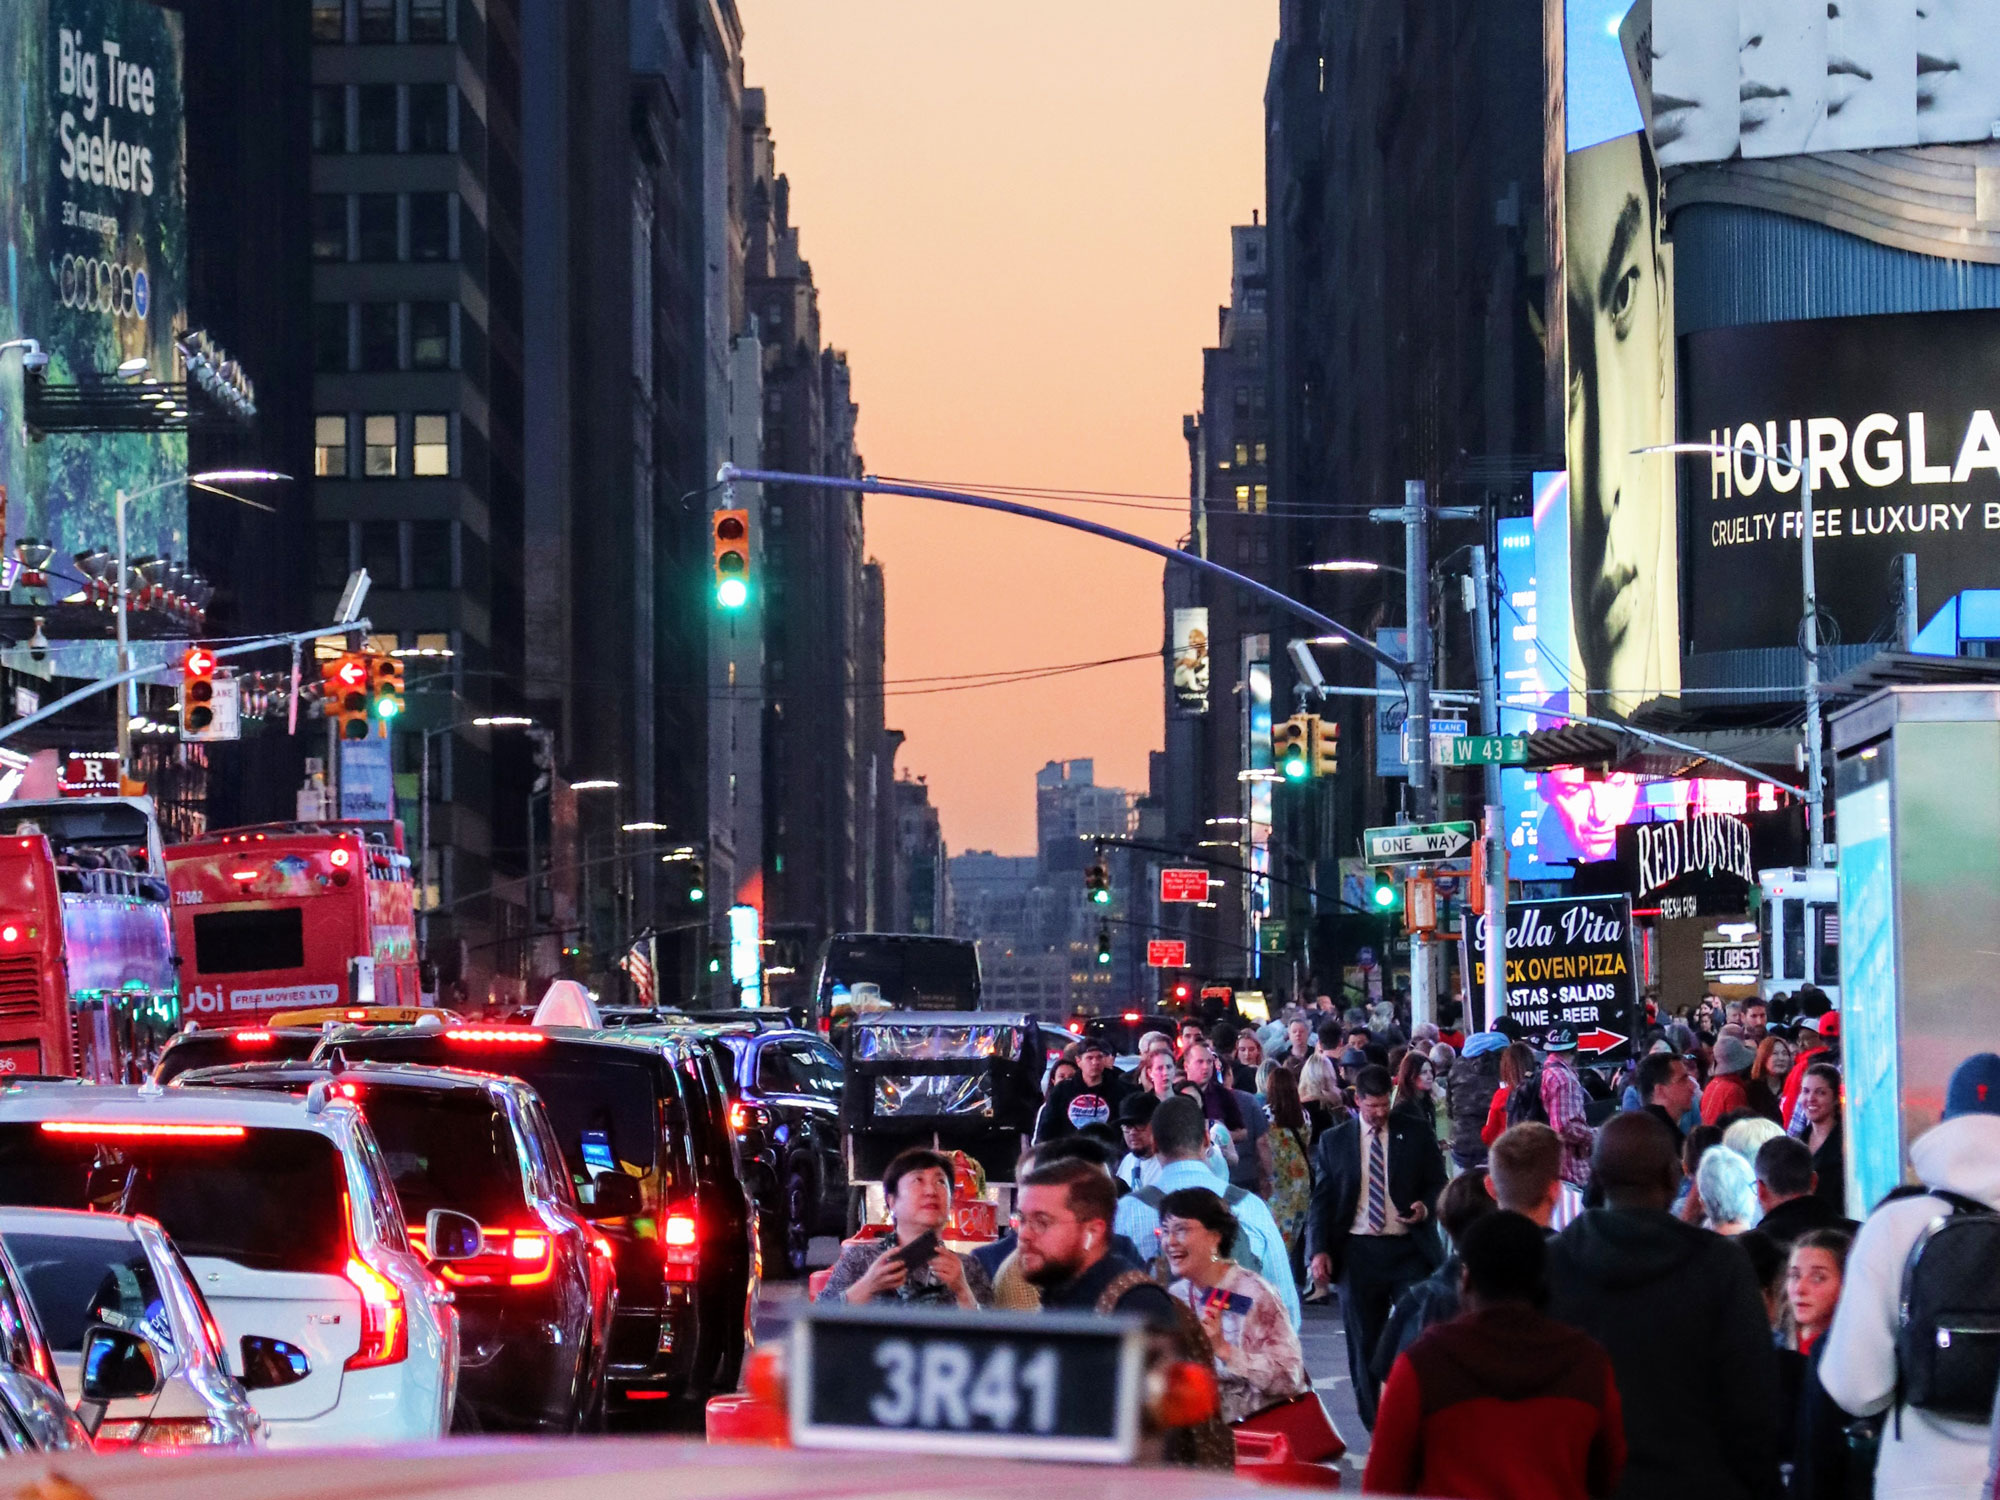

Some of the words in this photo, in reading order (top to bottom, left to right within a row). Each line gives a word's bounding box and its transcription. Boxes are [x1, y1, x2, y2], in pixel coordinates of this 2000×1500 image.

[59, 28, 98, 122] Big
[103, 39, 155, 116] Tree
[59, 111, 154, 197] Seekers
[1711, 409, 2000, 500] HOURGLA
[1711, 512, 1776, 547] CRUELTY
[1852, 503, 1972, 536] LUXURY
[1985, 502, 2000, 529] B
[1457, 740, 1473, 760] W
[1482, 740, 1503, 760] 43
[83, 760, 105, 781] R
[1382, 837, 1413, 853] ONE
[1426, 834, 1458, 850] WAY
[1636, 824, 1679, 898] RED
[1683, 812, 1754, 885] LOBSTER
[1660, 897, 1682, 919] FRESH
[1560, 906, 1624, 945] Vita
[1475, 958, 1527, 985] BCK
[1528, 956, 1576, 981] OVEN
[1578, 953, 1627, 977] PIZZA
[1717, 948, 1759, 968] LOBST
[182, 984, 224, 1014] ubi
[235, 994, 262, 1004] FREE
[265, 990, 307, 1002] MOVIES
[319, 989, 332, 999] TV
[1506, 987, 1549, 1007] ASTAS
[1559, 983, 1615, 1003] SALADS
[400, 1010, 419, 1020] 477
[1511, 1009, 1549, 1026] WINE
[1562, 1006, 1599, 1023] BEER
[869, 1337, 1061, 1433] 3R41
